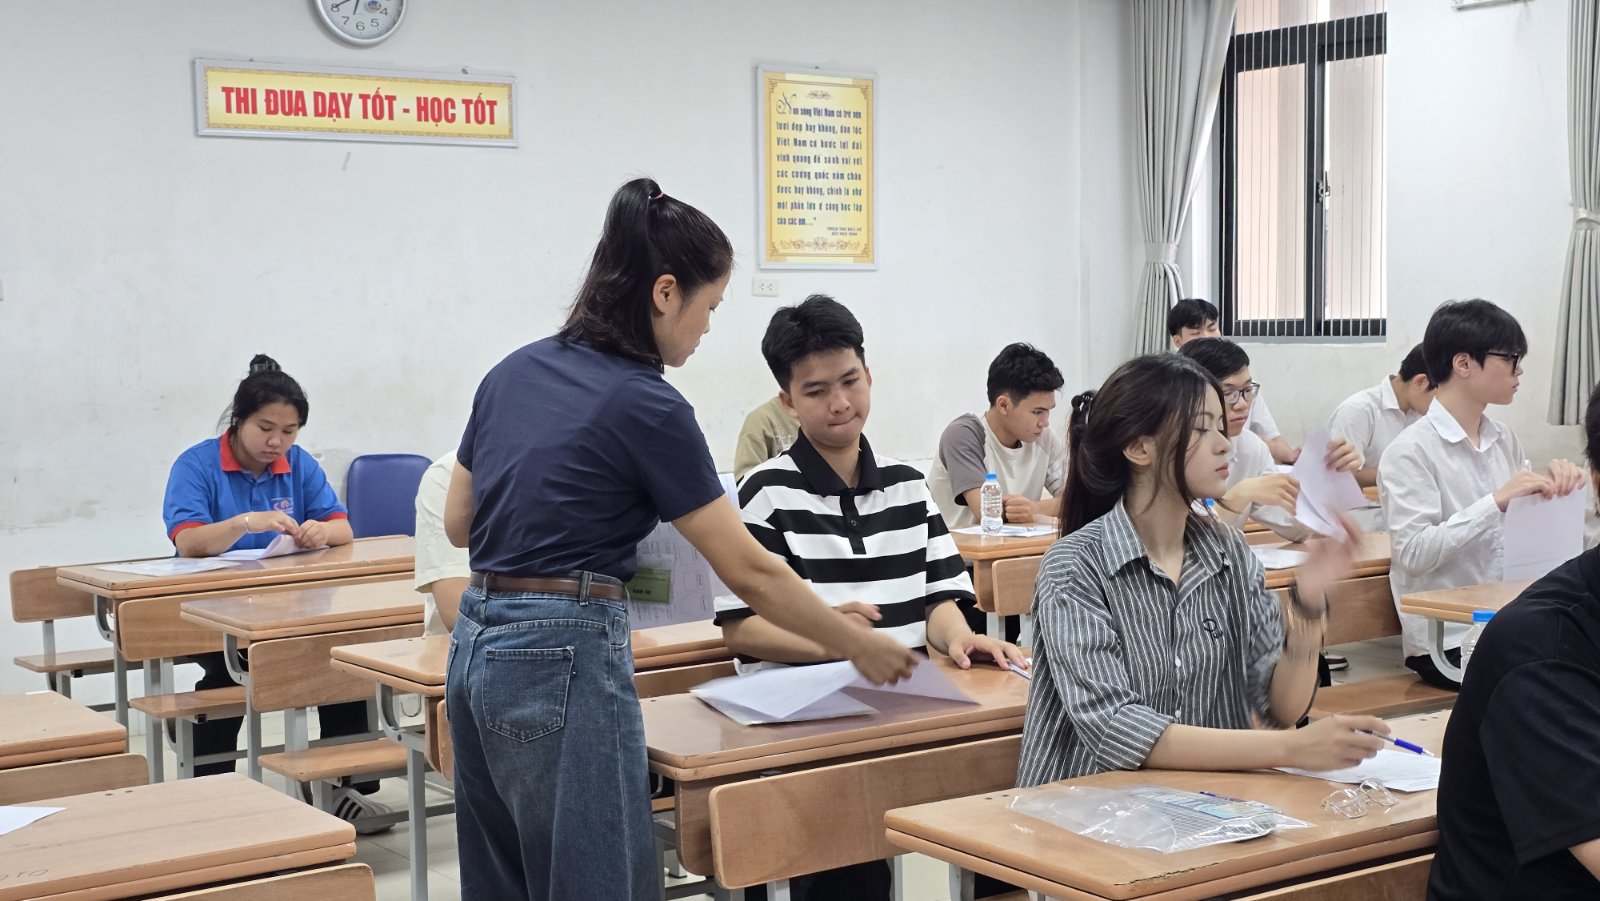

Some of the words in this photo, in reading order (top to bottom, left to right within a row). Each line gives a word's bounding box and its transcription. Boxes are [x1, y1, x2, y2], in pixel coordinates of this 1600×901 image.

[341, 16, 350, 25] 7
[370, 18, 379, 27] 5
[356, 21, 365, 31] 6
[221, 86, 258, 115] THI
[264, 89, 308, 117] ĐUA
[313, 91, 353, 122] DẠY
[359, 87, 397, 121] TỐT
[416, 96, 456, 127] HỌC
[462, 92, 497, 125] TỐT
